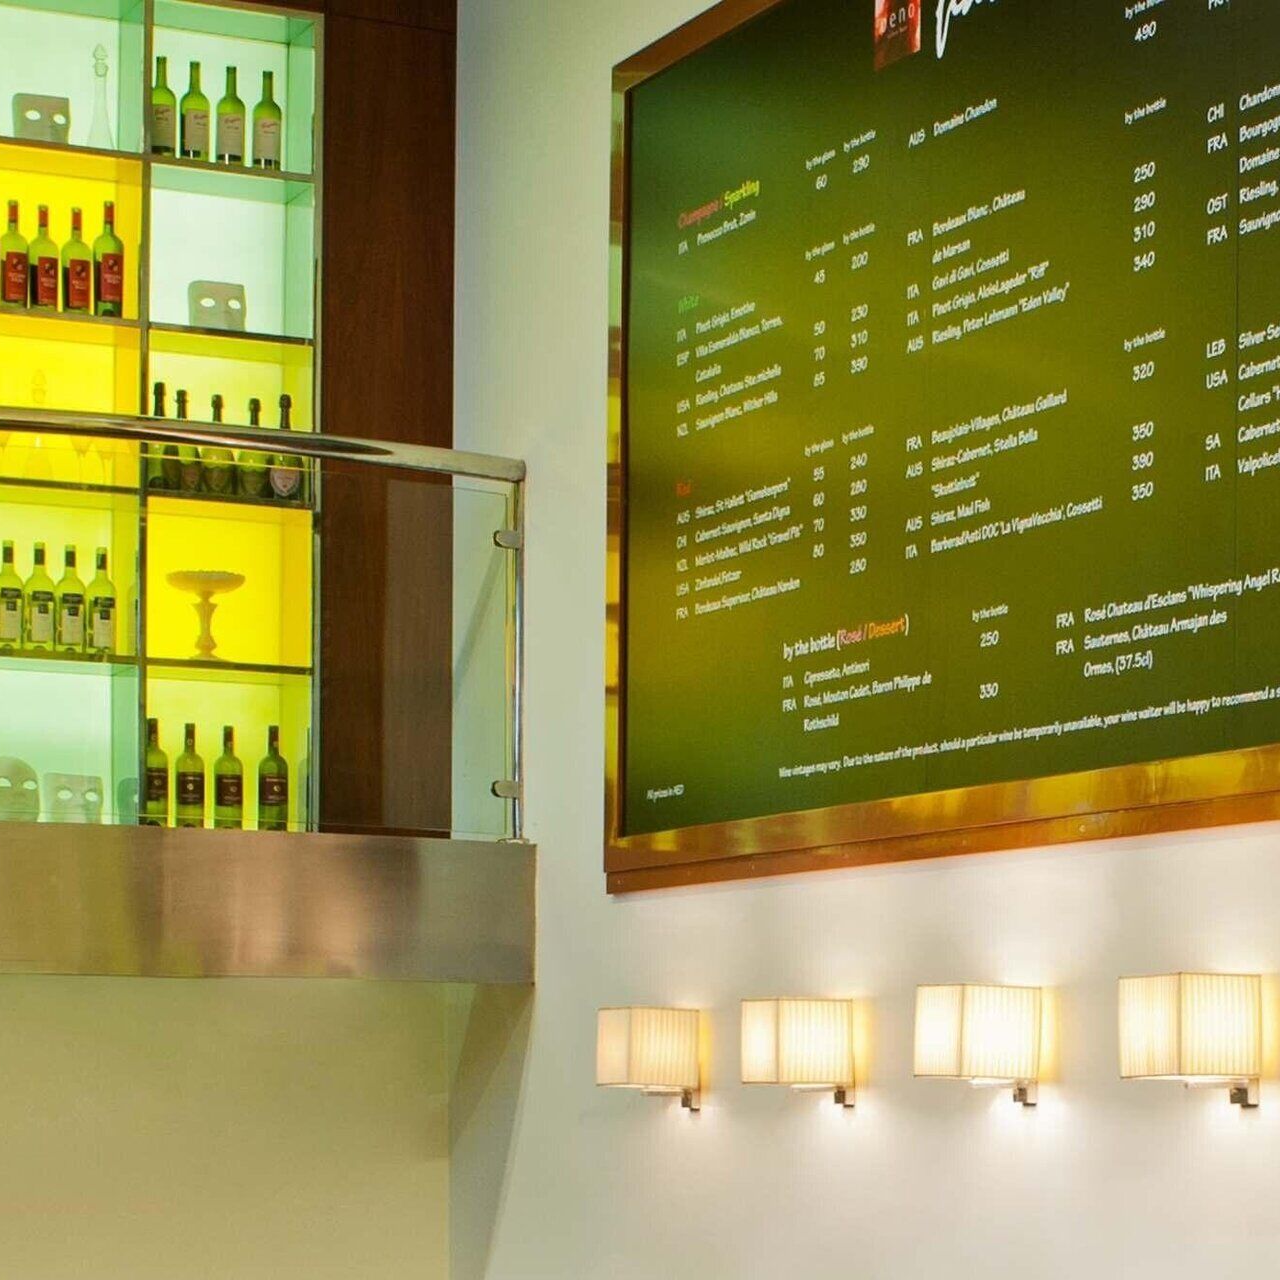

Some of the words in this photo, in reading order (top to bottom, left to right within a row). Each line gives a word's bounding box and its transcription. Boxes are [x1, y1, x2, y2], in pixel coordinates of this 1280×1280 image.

[1134, 20, 1157, 42] 490
[1207, 132, 1229, 154] FRA
[1133, 220, 1156, 243] 310
[1206, 224, 1228, 246] FRA
[1133, 250, 1156, 272] 340
[1132, 360, 1155, 382] 320
[1206, 369, 1229, 390] USA
[1205, 463, 1222, 482] ITA
[1056, 611, 1075, 629] FRA
[1055, 638, 1075, 655] FRA
[979, 682, 999, 700] 330
